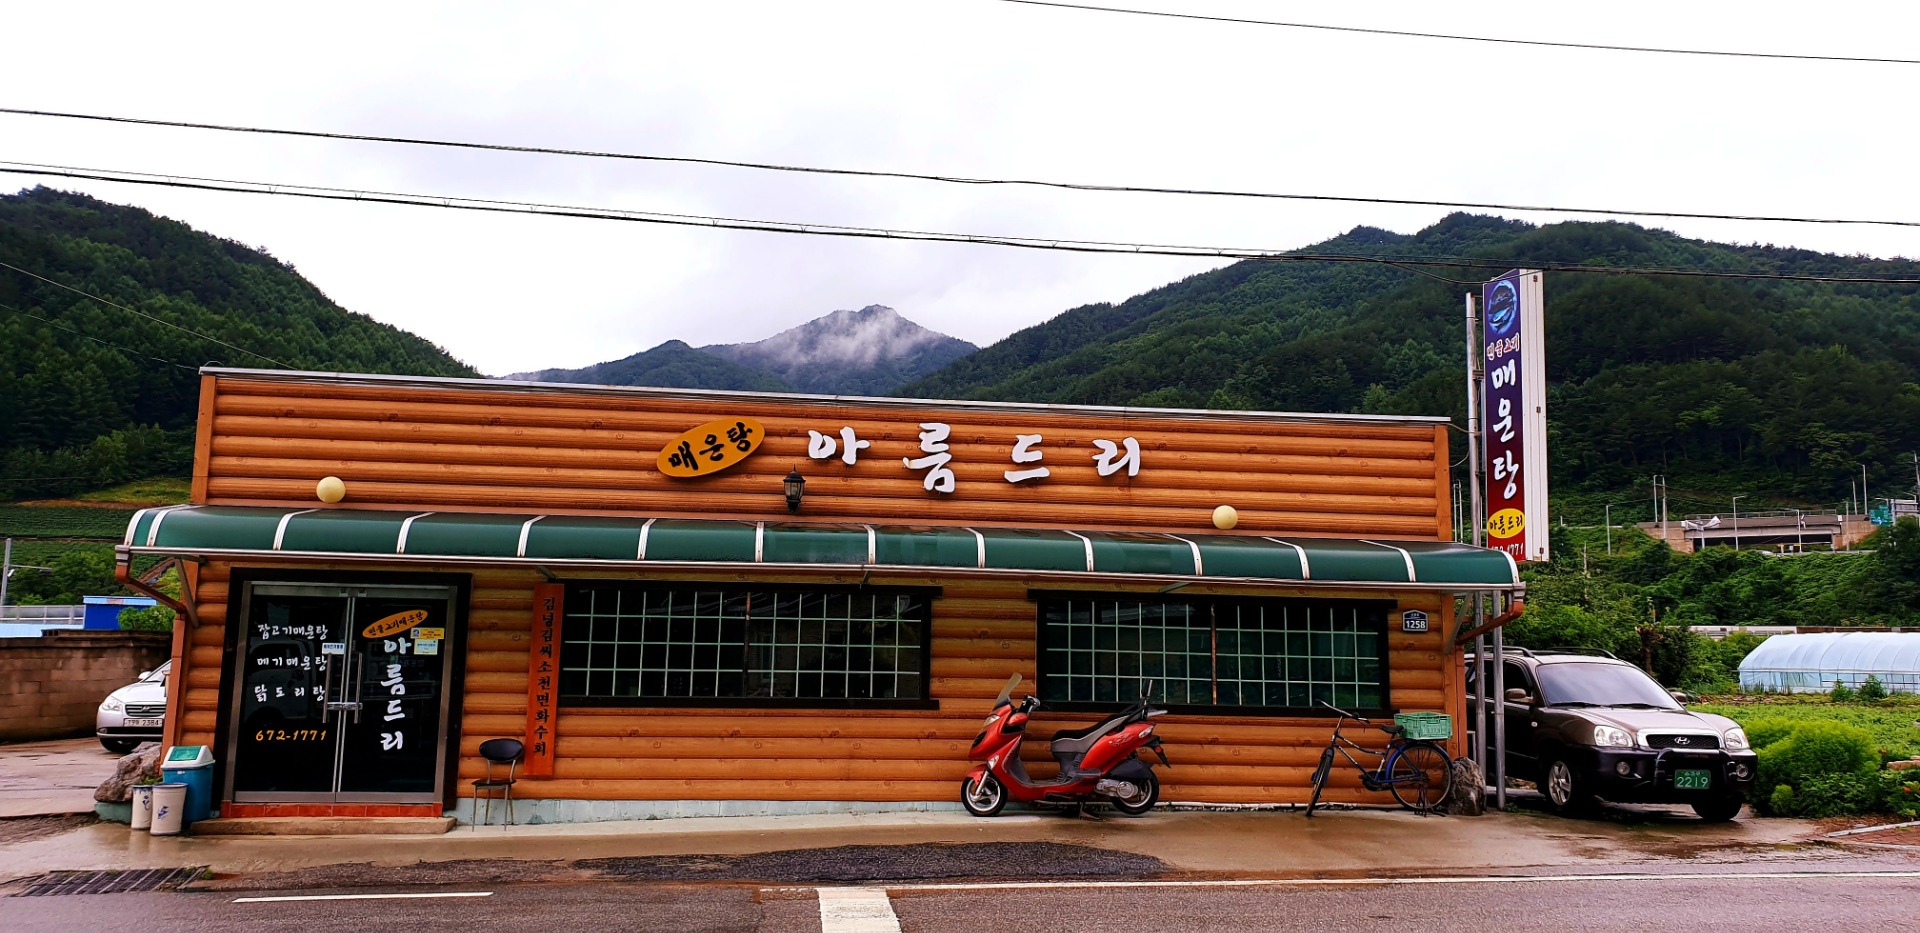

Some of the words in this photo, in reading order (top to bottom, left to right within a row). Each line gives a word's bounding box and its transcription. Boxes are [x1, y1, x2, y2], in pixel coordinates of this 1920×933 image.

[1491, 359, 1519, 500] 매운탕
[667, 420, 754, 472] 매운탕
[807, 422, 1141, 494] 아름드리
[1489, 514, 1523, 535] 아름드리
[257, 623, 329, 640] 잡고기매운탕
[1405, 620, 1426, 629] 1258
[256, 655, 328, 672] 메기매운탕
[254, 684, 326, 703] 닭도리탕
[380, 636, 412, 751] 아름드리
[255, 729, 327, 741] 672-1771
[1676, 776, 1709, 788] 2219
